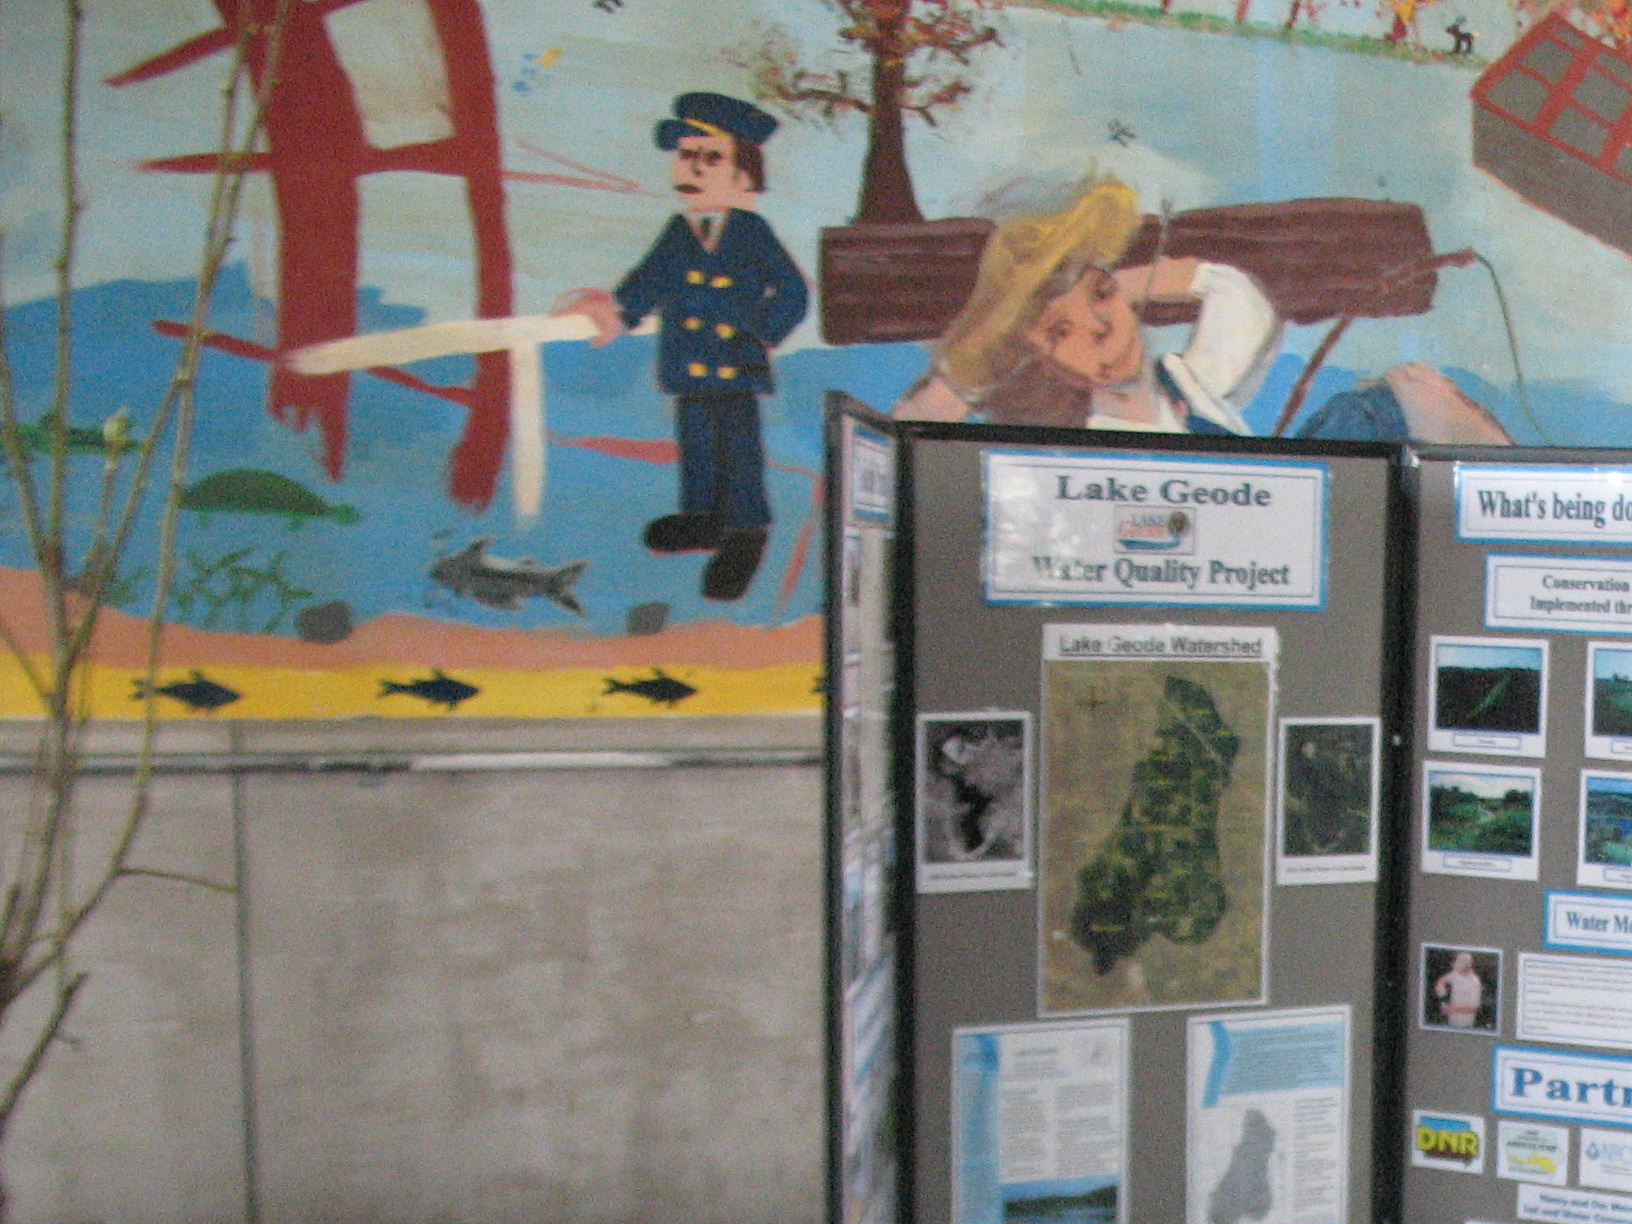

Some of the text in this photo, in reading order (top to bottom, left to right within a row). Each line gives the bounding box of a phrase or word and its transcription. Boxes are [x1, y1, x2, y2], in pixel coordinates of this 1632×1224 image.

[1055, 475, 1271, 506] Lake Geode
[1477, 490, 1546, 519] What's
[1552, 492, 1606, 528] being
[1113, 558, 1199, 589] Quality
[1208, 560, 1290, 590] Project
[1542, 575, 1630, 592] Conservation
[1530, 595, 1610, 614] Implemented
[1059, 635, 1262, 655] Lake Geode Watershed
[1566, 911, 1609, 931] Water
[1416, 1125, 1480, 1157] DNR
